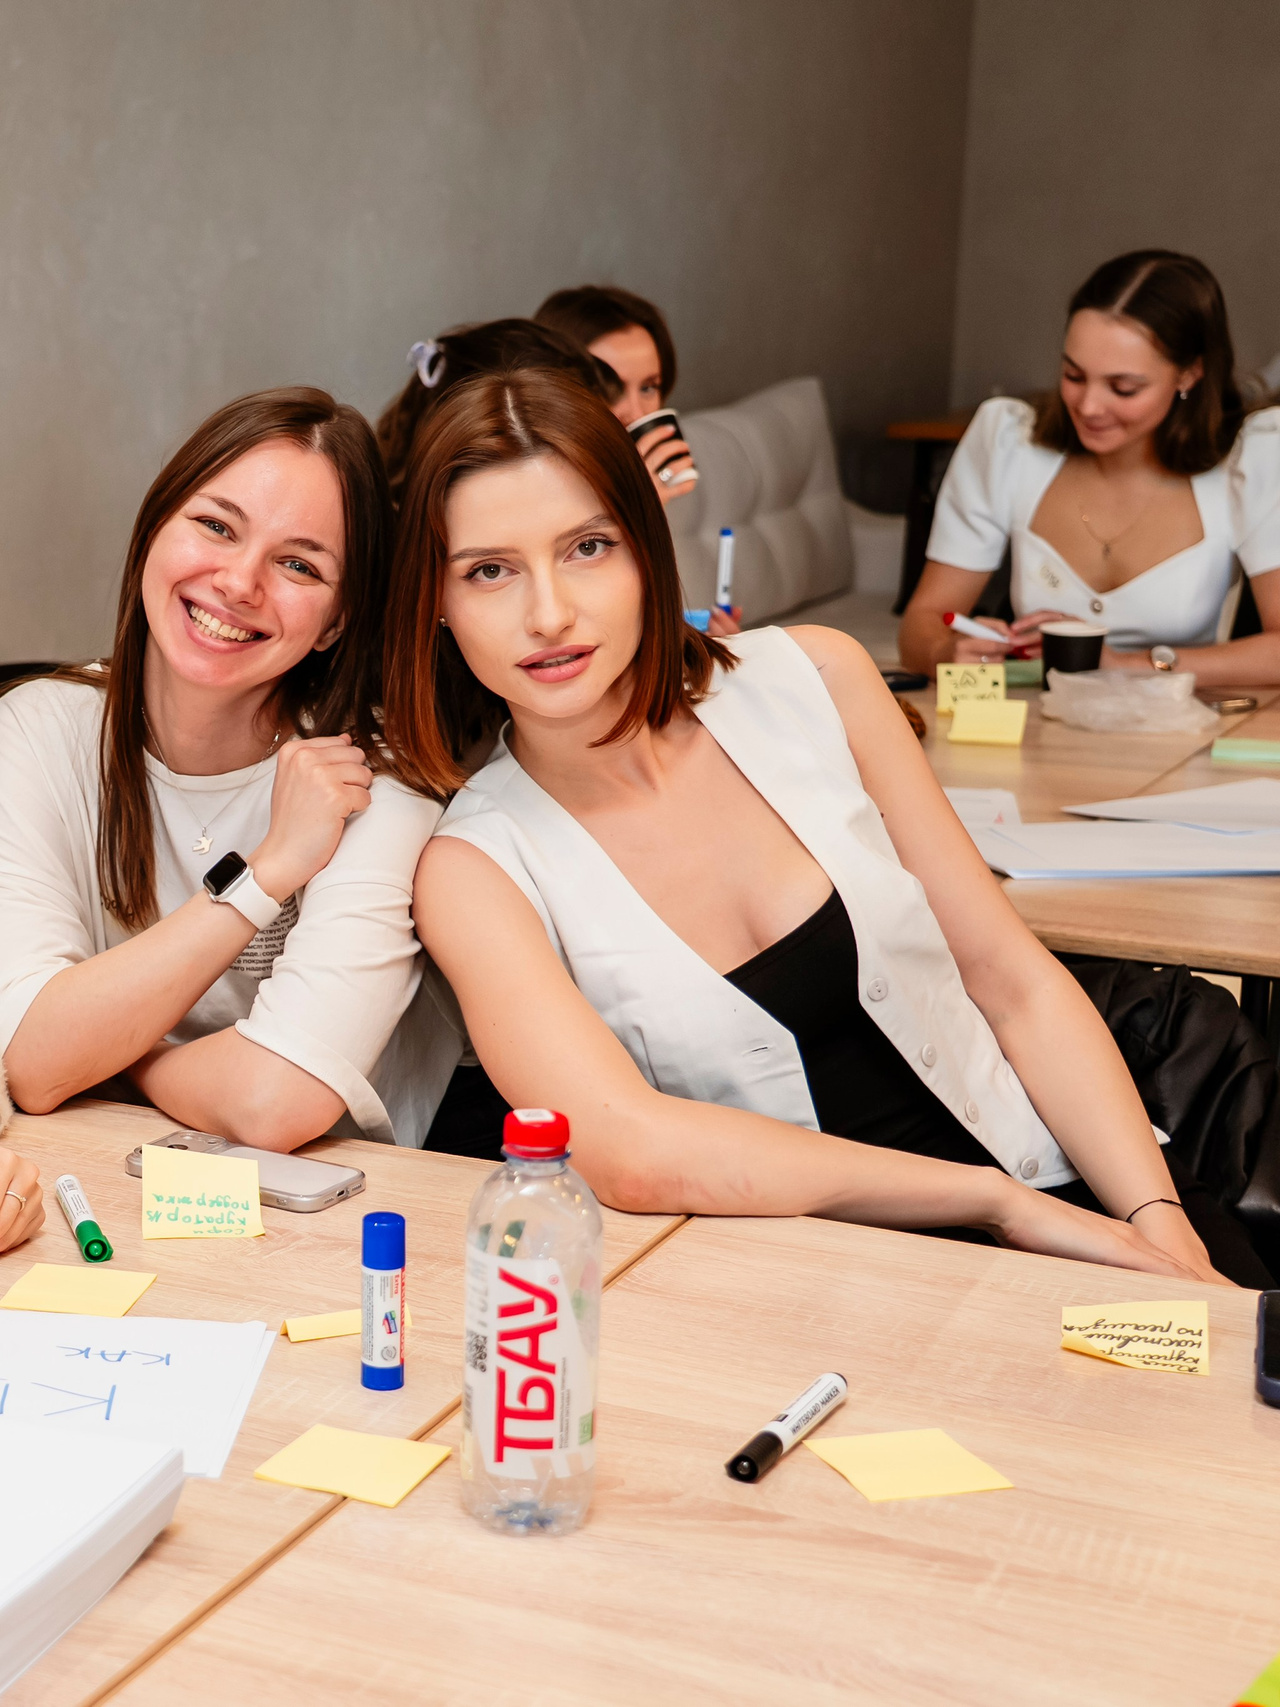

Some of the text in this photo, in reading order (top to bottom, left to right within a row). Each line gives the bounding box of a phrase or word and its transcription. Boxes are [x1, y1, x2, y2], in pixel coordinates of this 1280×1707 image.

[56, 1345, 171, 1366] КАК
[494, 1267, 558, 1463] ТБАУ
[790, 1402, 821, 1435] WHITEBOARD
[819, 1385, 840, 1408] MARKER
